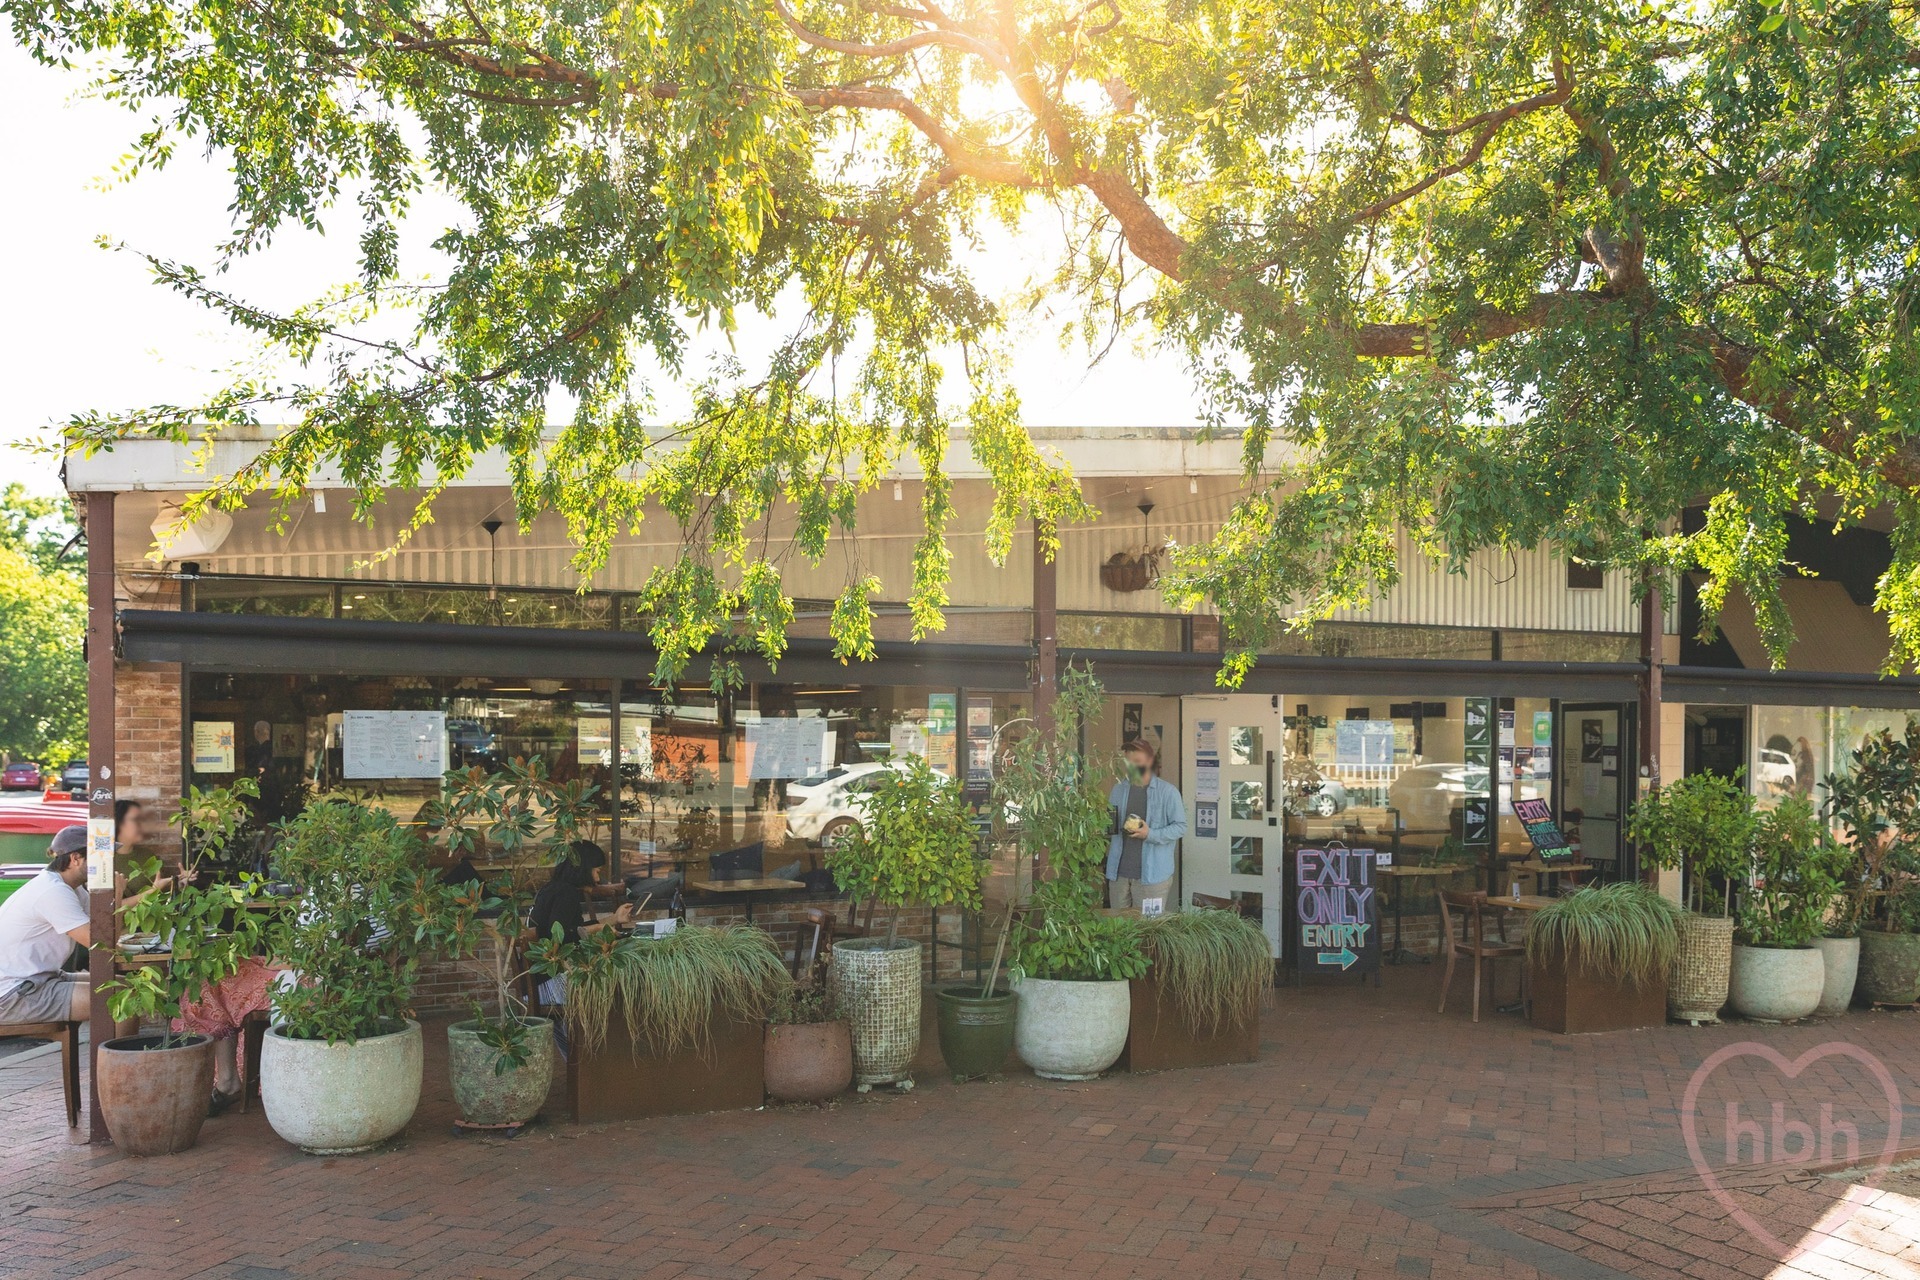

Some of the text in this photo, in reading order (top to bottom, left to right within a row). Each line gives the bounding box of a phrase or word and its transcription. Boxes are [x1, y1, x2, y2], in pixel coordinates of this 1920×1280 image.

[1514, 800, 1551, 820] ENTRY
[1297, 848, 1375, 886] EXIT
[1298, 886, 1373, 924] ONLY
[1302, 923, 1371, 947] ENTRY
